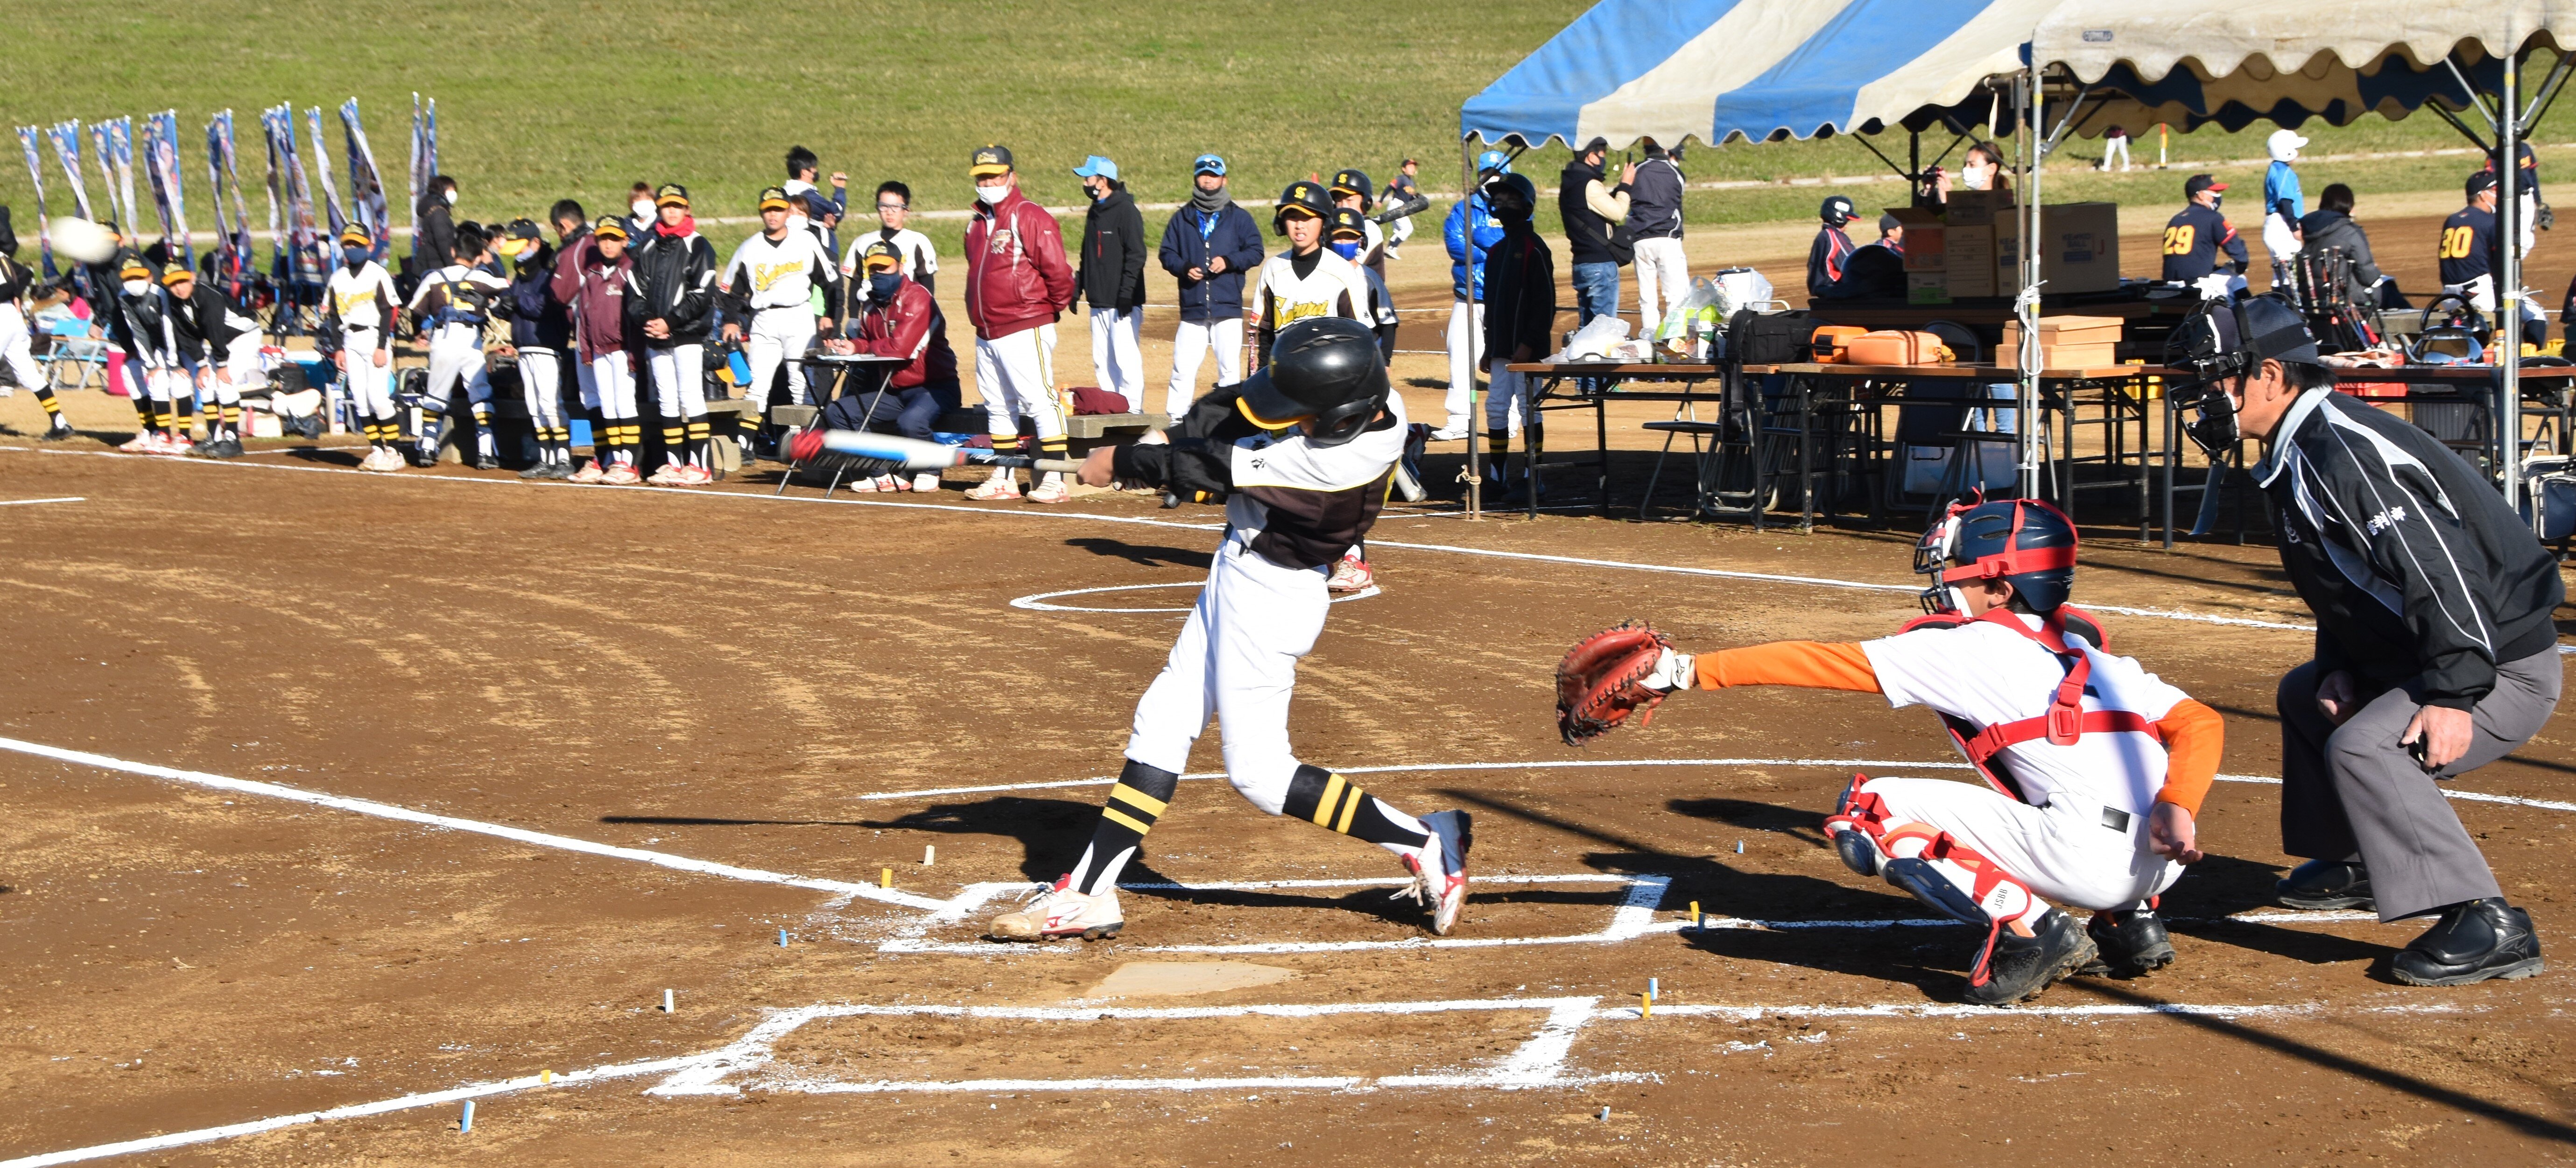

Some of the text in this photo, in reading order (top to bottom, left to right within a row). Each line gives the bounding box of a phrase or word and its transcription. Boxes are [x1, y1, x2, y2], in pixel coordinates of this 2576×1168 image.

[1338, 173, 1348, 184] S
[1294, 186, 1307, 199] S
[1339, 212, 1349, 224] S
[2163, 225, 2195, 255] 29
[2439, 226, 2474, 259] 30
[1273, 296, 1329, 331] Sakura
[1994, 888, 2008, 909] JSBB
